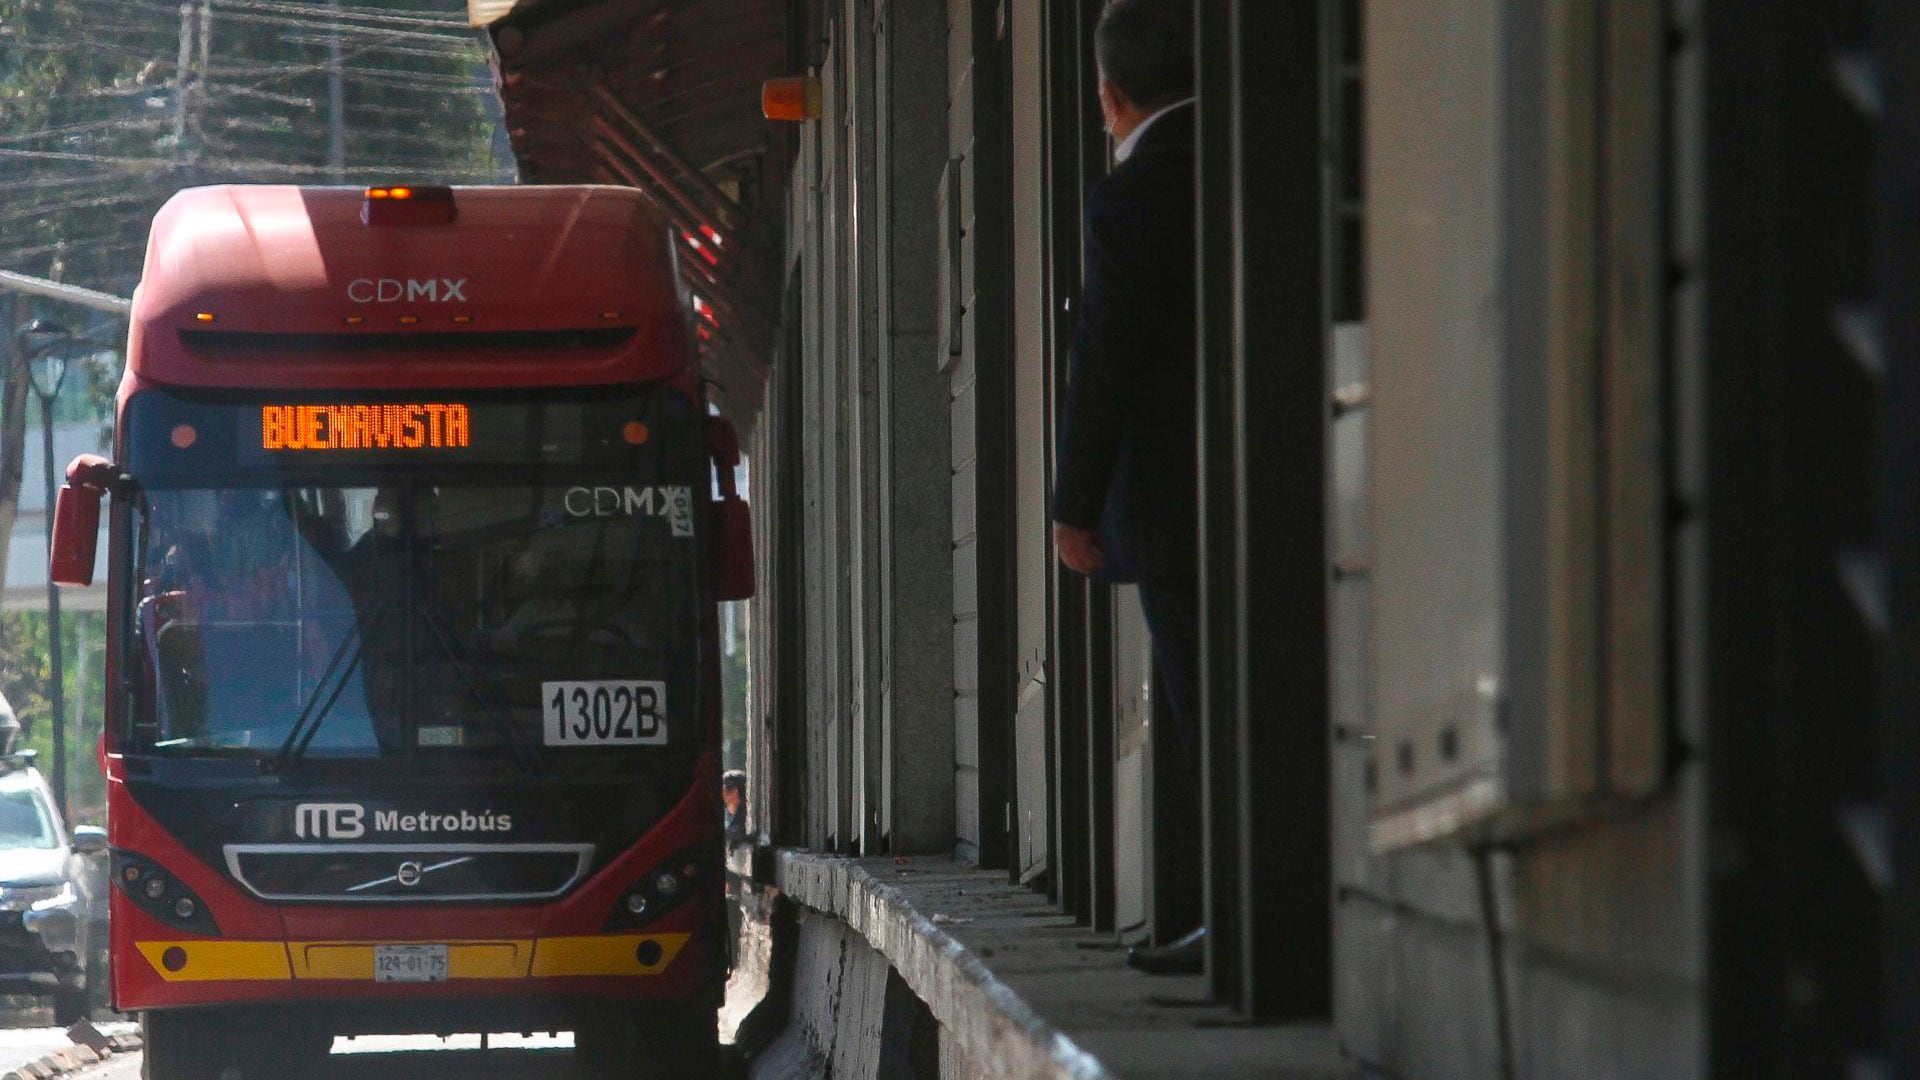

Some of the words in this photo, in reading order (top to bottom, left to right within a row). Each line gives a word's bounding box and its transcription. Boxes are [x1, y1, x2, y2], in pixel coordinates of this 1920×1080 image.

[347, 278, 467, 302] CDMX
[262, 403, 469, 449] BUENAVISTA
[564, 486, 680, 516] CDMX
[551, 686, 660, 740] 1302B
[295, 803, 365, 838] MB
[374, 809, 513, 832] Metrobús
